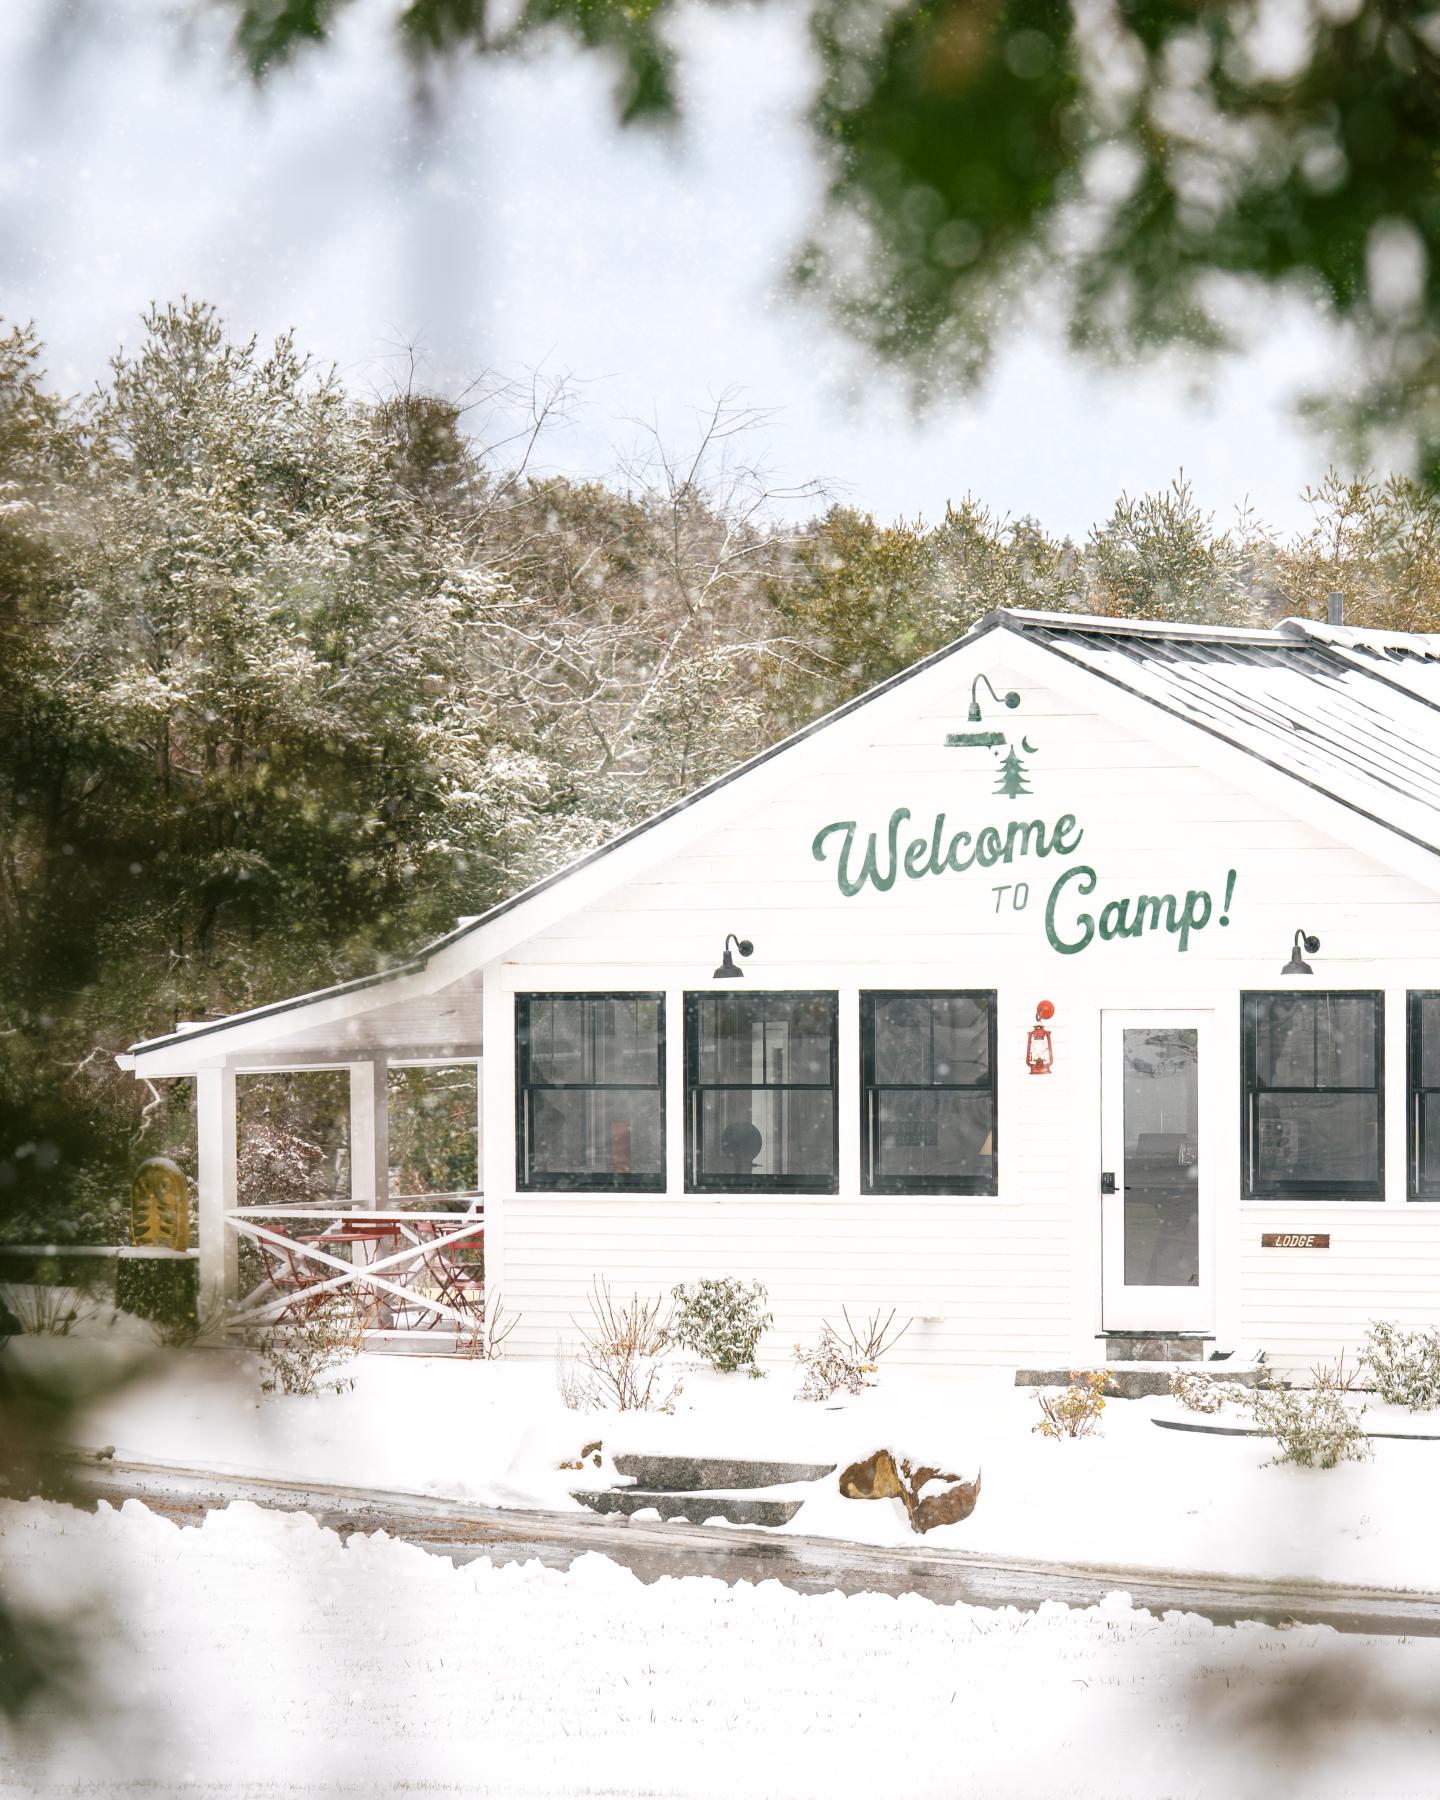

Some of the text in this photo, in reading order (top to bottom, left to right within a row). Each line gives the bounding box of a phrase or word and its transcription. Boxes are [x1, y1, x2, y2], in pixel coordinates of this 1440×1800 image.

[811, 807, 1084, 898] Welcome
[991, 865, 1238, 956] TO Camp!
[1275, 1235, 1315, 1247] LODGE
